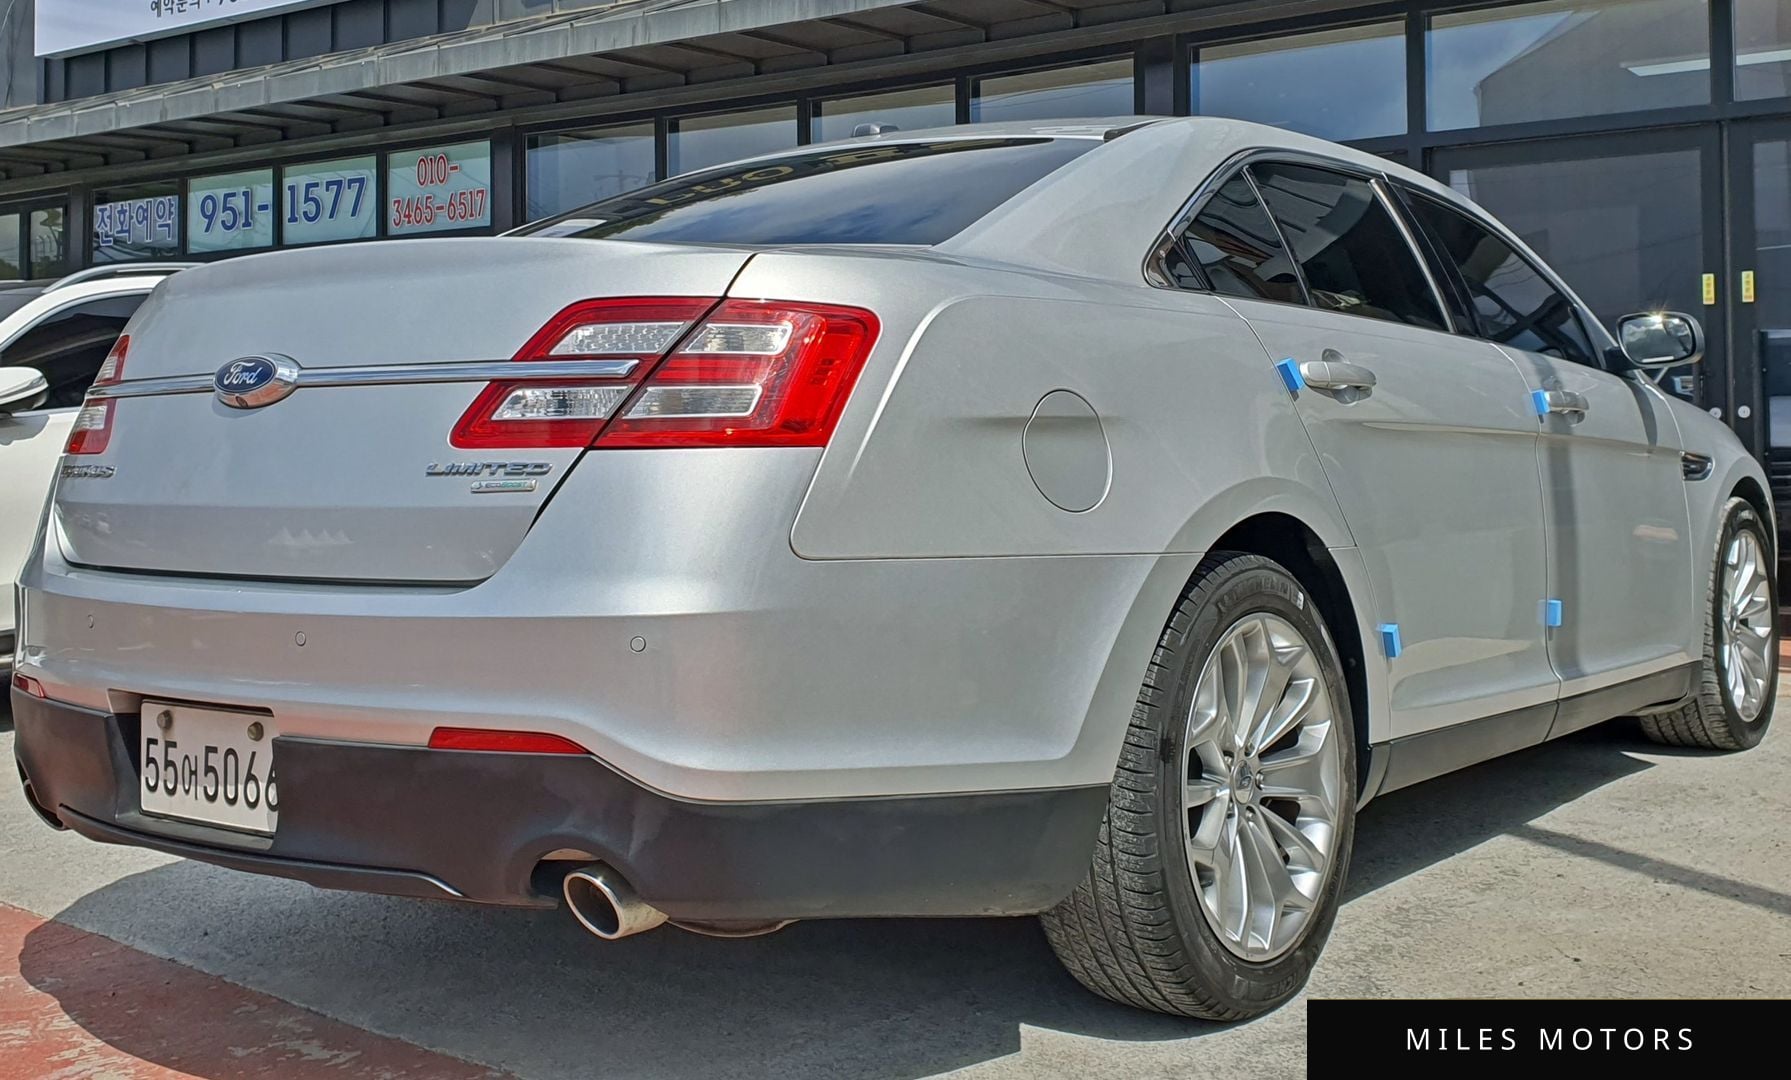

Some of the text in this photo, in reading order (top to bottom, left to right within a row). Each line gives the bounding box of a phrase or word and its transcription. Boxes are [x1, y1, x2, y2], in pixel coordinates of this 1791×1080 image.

[416, 153, 460, 186] 010-
[96, 196, 175, 247] 전화예약
[287, 175, 367, 225] 1577
[392, 187, 486, 229] 3465-6517
[223, 361, 263, 386] Ford
[425, 461, 553, 477] LIMITED
[145, 737, 279, 812] 55어5066
